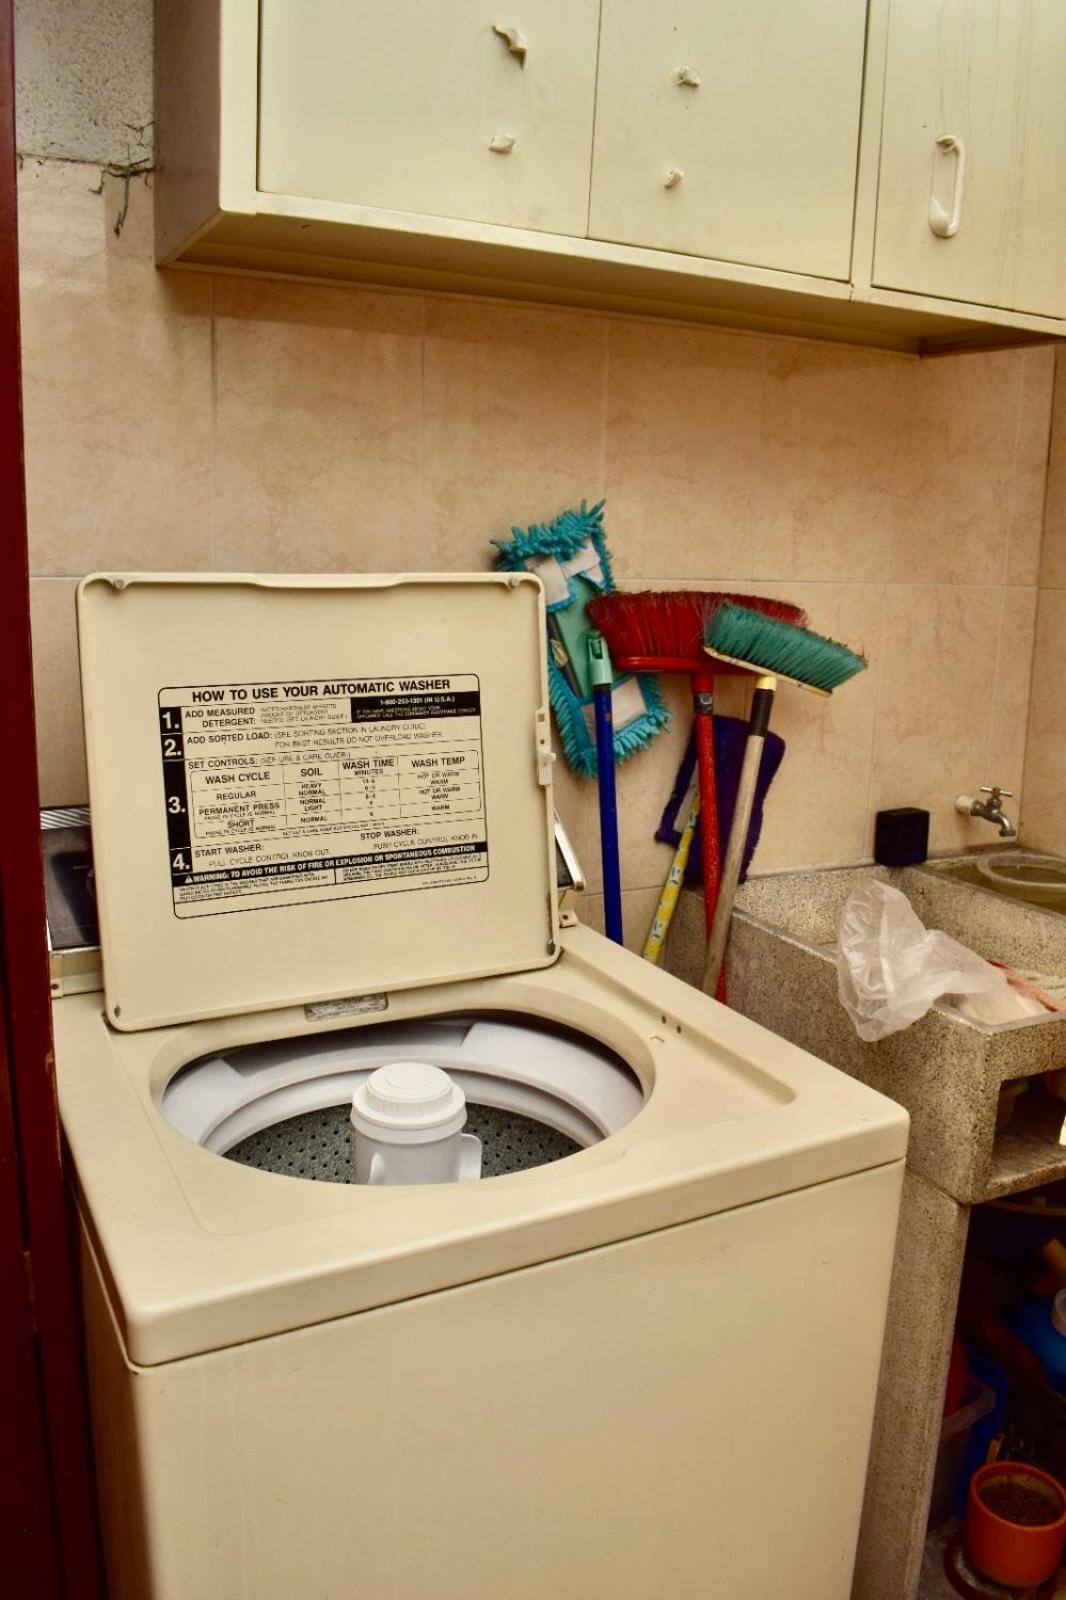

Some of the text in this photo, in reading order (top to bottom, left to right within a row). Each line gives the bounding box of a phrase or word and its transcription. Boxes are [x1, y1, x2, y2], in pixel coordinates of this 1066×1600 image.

[193, 680, 450, 702] HOW TO USE YOUR AUTOMATIC WASHER
[207, 708, 255, 716] MEASURED
[162, 712, 179, 729] 1.
[202, 718, 255, 727] DETERGENT:
[209, 734, 243, 743] SORTED
[247, 732, 272, 740] LOAD:
[164, 740, 181, 756] 2.
[189, 761, 207, 769] SET
[209, 759, 257, 767] CONTROLS:
[342, 759, 394, 769] WASH TIME
[412, 757, 465, 767] WASH TEMP
[301, 768, 322, 776] SOIL
[205, 772, 270, 784] WASH CYCLE
[216, 791, 256, 800] REGULAR
[298, 788, 326, 796] NORMAL
[168, 797, 186, 813] 3.
[199, 805, 249, 815] PERMANENT
[227, 820, 254, 828] SHORT
[361, 832, 381, 840] STOP
[384, 829, 420, 837] WASHER:
[195, 844, 264, 857] START WASHER:
[173, 853, 190, 870] 4.
[241, 868, 263, 877] AVOID
[280, 864, 296, 872] RISK
[298, 862, 306, 870] OF
[308, 860, 323, 869] FIRE
[325, 859, 334, 867] OR
[336, 856, 373, 866] EXPLOSION
[385, 849, 432, 861] SPONTANEOUS
[433, 845, 475, 854] COMBUSTION
